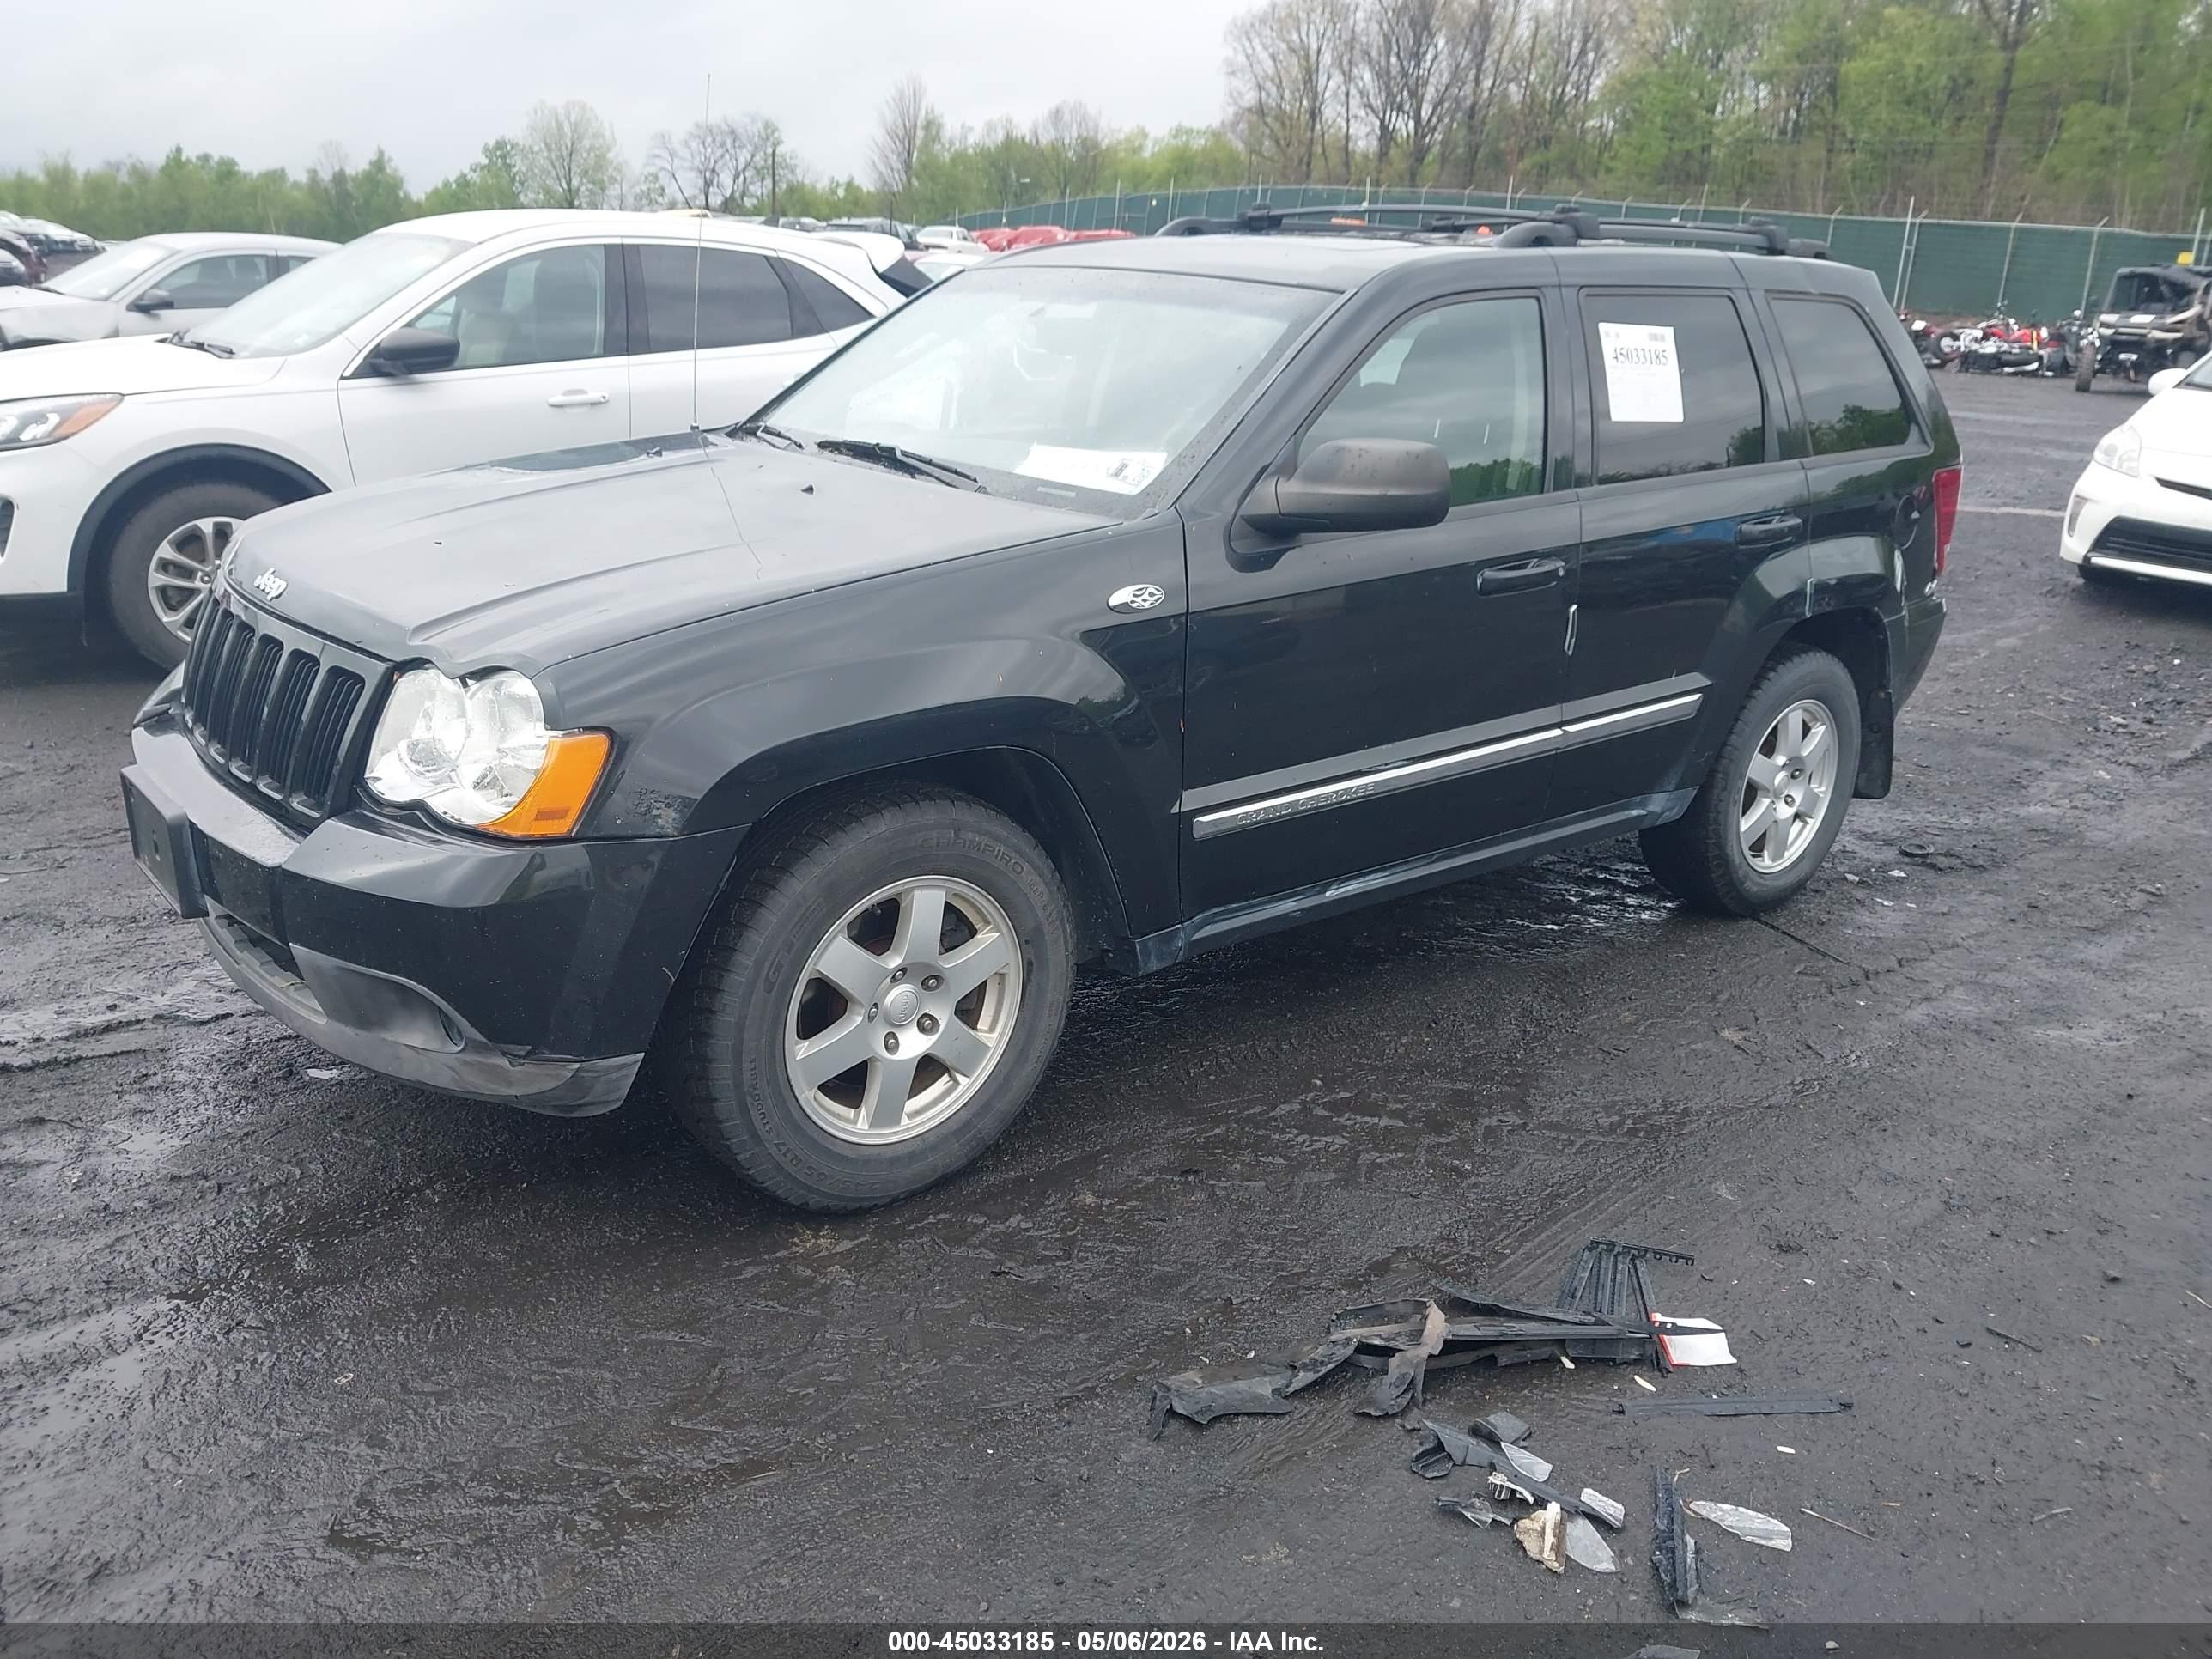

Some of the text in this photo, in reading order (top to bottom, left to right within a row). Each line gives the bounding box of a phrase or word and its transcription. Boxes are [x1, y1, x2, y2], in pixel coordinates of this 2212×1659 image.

[1613, 346, 1668, 366] 45033185
[253, 568, 288, 601] Jeep
[1237, 782, 1375, 825] GRAND CHEROKEE
[920, 836, 1024, 875] CHAMPIRO
